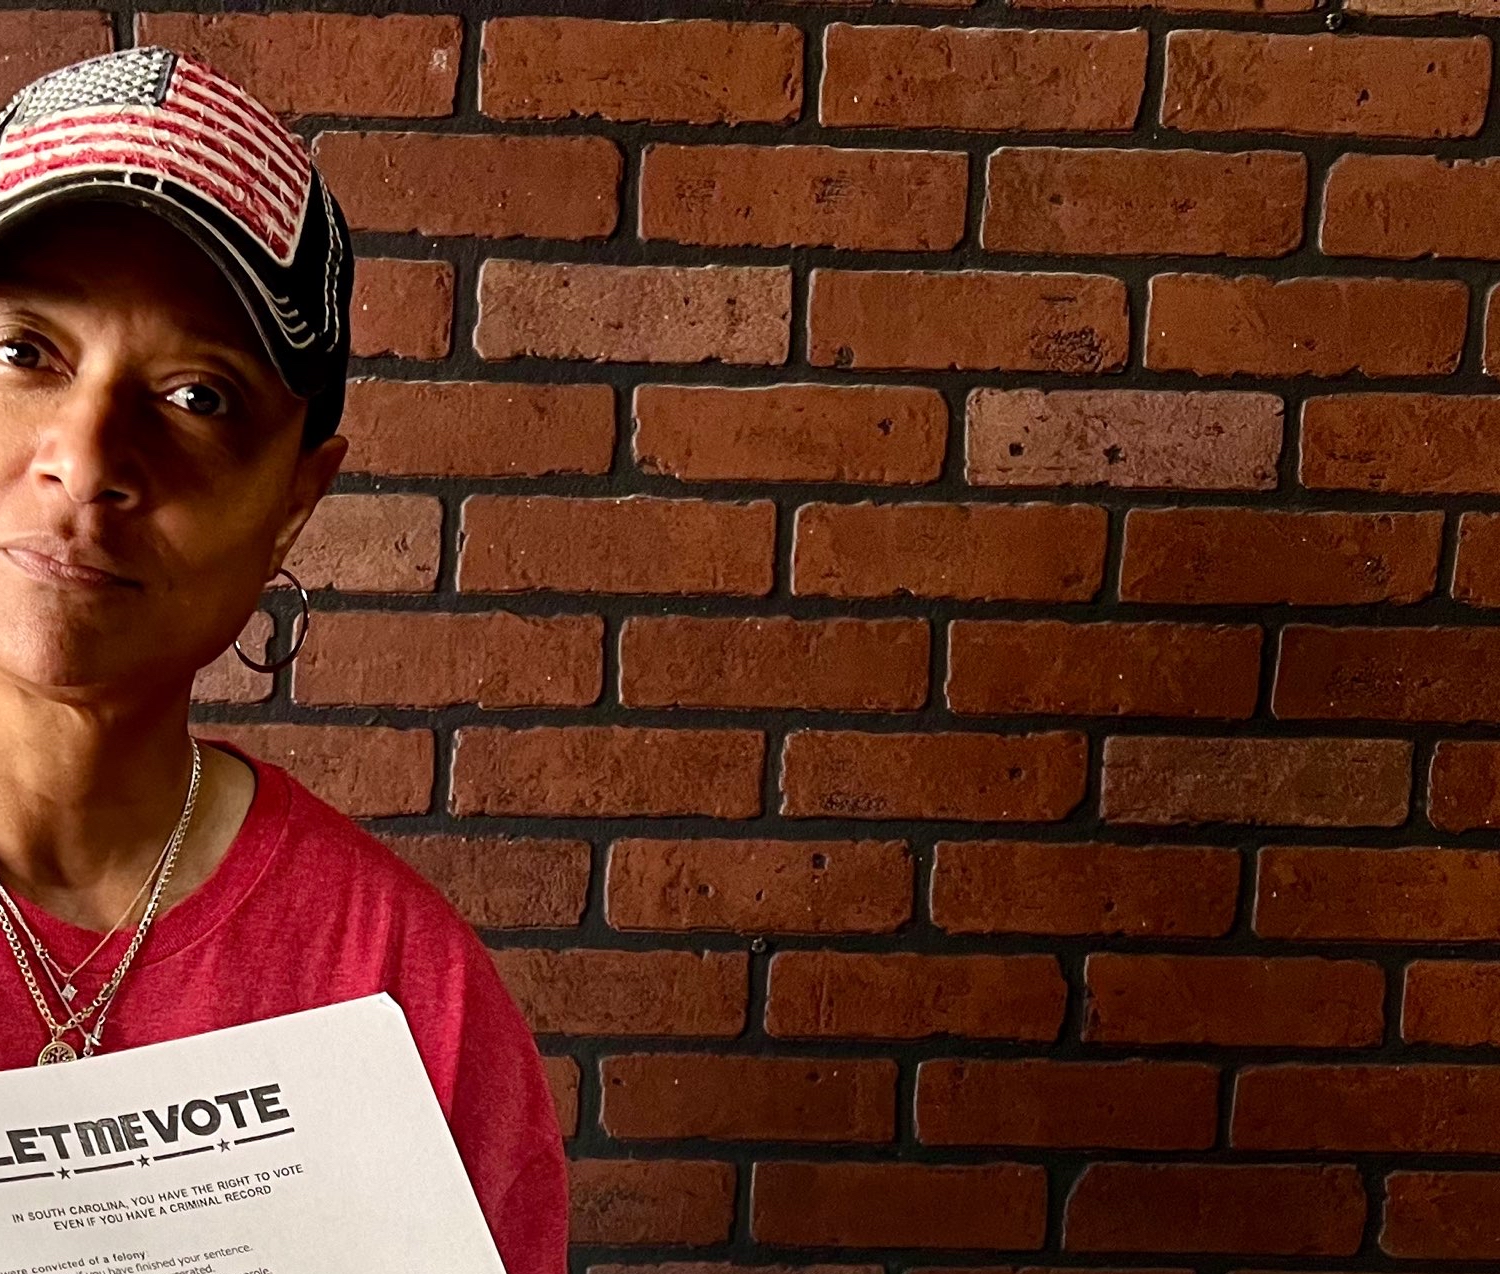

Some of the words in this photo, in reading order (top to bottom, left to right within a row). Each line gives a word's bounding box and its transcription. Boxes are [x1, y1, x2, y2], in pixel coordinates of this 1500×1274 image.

[11, 1213, 25, 1224] IN
[27, 1207, 66, 1221] SOUTH
[69, 1200, 130, 1215] CAROLINA,
[130, 1194, 155, 1207] YOU
[158, 1188, 189, 1202] HAVE
[190, 1183, 215, 1196] THE
[216, 1175, 250, 1191] RIGHT
[253, 1171, 271, 1183] TO
[272, 1163, 304, 1178] VOTE
[53, 1218, 85, 1231] EVEN
[86, 1217, 96, 1227] IF
[98, 1213, 123, 1225] YOU
[125, 1207, 157, 1221] HAVE
[159, 1206, 168, 1215] A
[169, 1195, 223, 1213] CRIMINAL
[224, 1185, 272, 1203] RECORD
[31, 1258, 85, 1274] convicted
[88, 1256, 100, 1266] of
[102, 1256, 110, 1264] a
